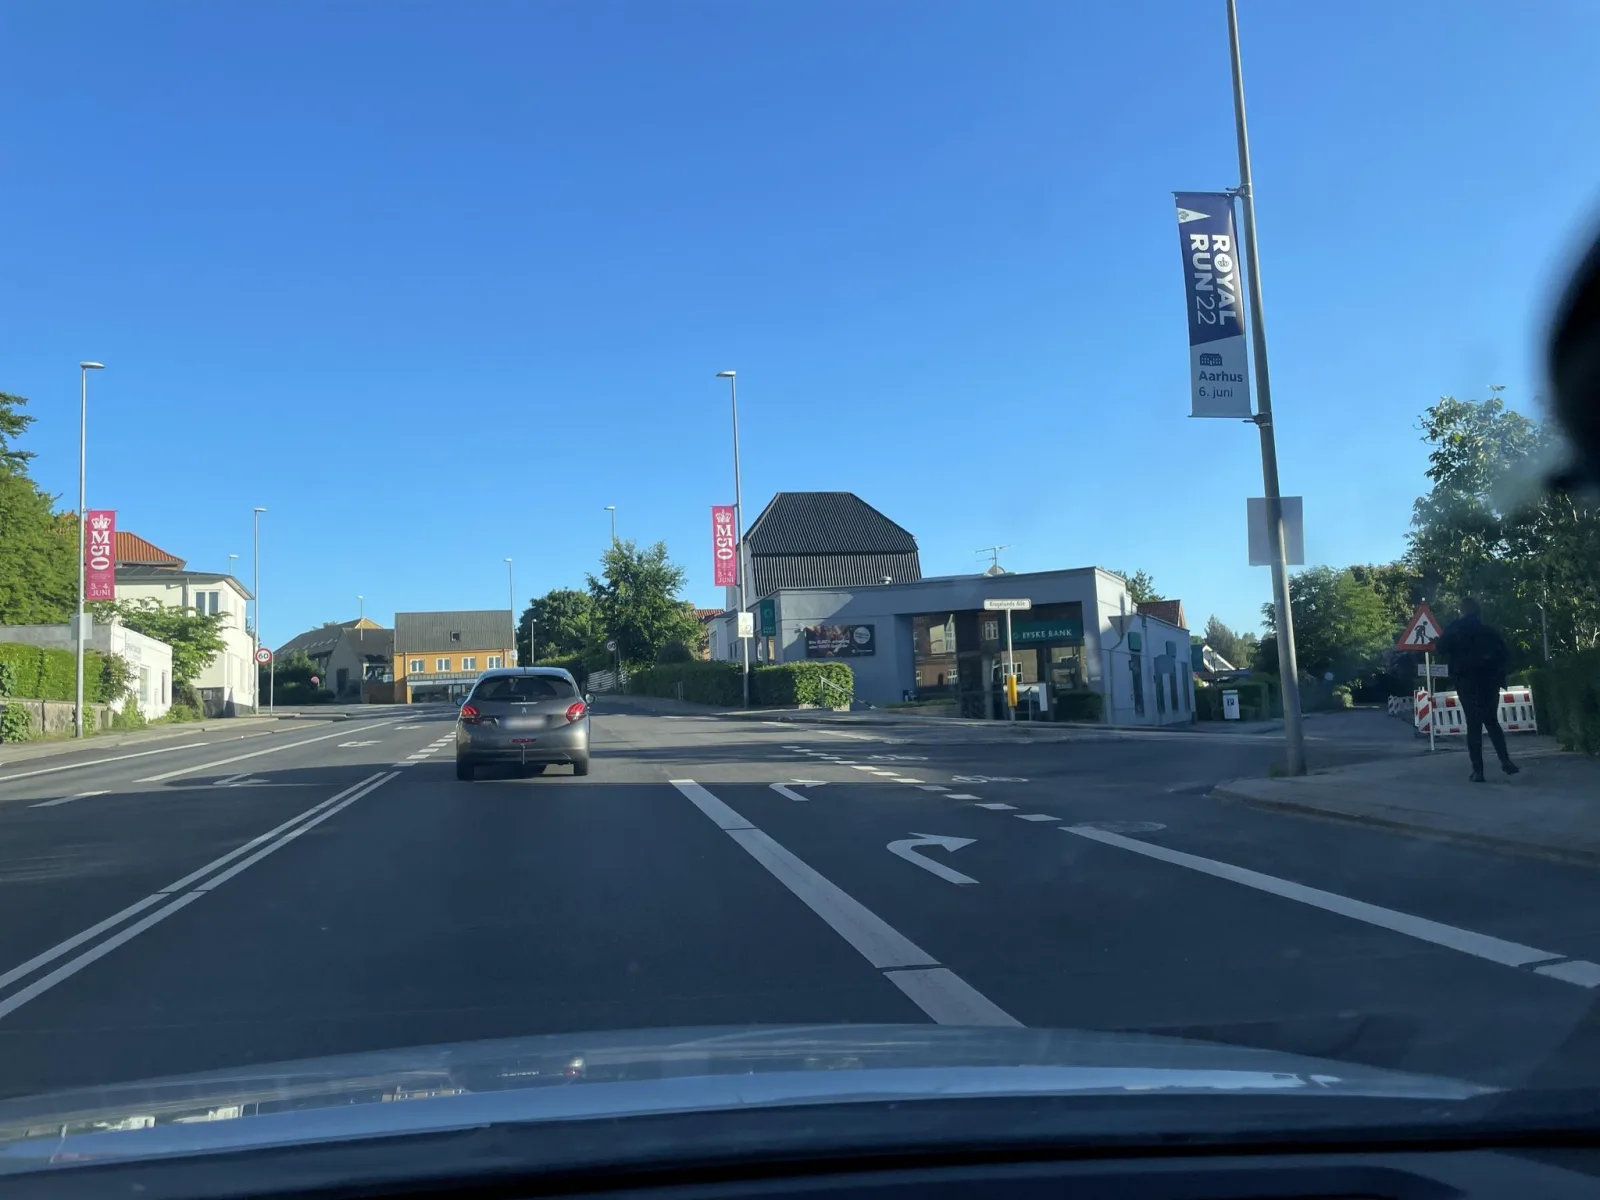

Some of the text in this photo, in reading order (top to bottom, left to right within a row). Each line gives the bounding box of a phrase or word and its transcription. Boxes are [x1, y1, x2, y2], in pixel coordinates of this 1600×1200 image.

[1212, 234, 1237, 325] ROYAL
[1199, 370, 1243, 382] Aarhus
[1199, 386, 1234, 399] 6. juni
[1048, 629, 1072, 638] BANK
[258, 652, 269, 660] 60
